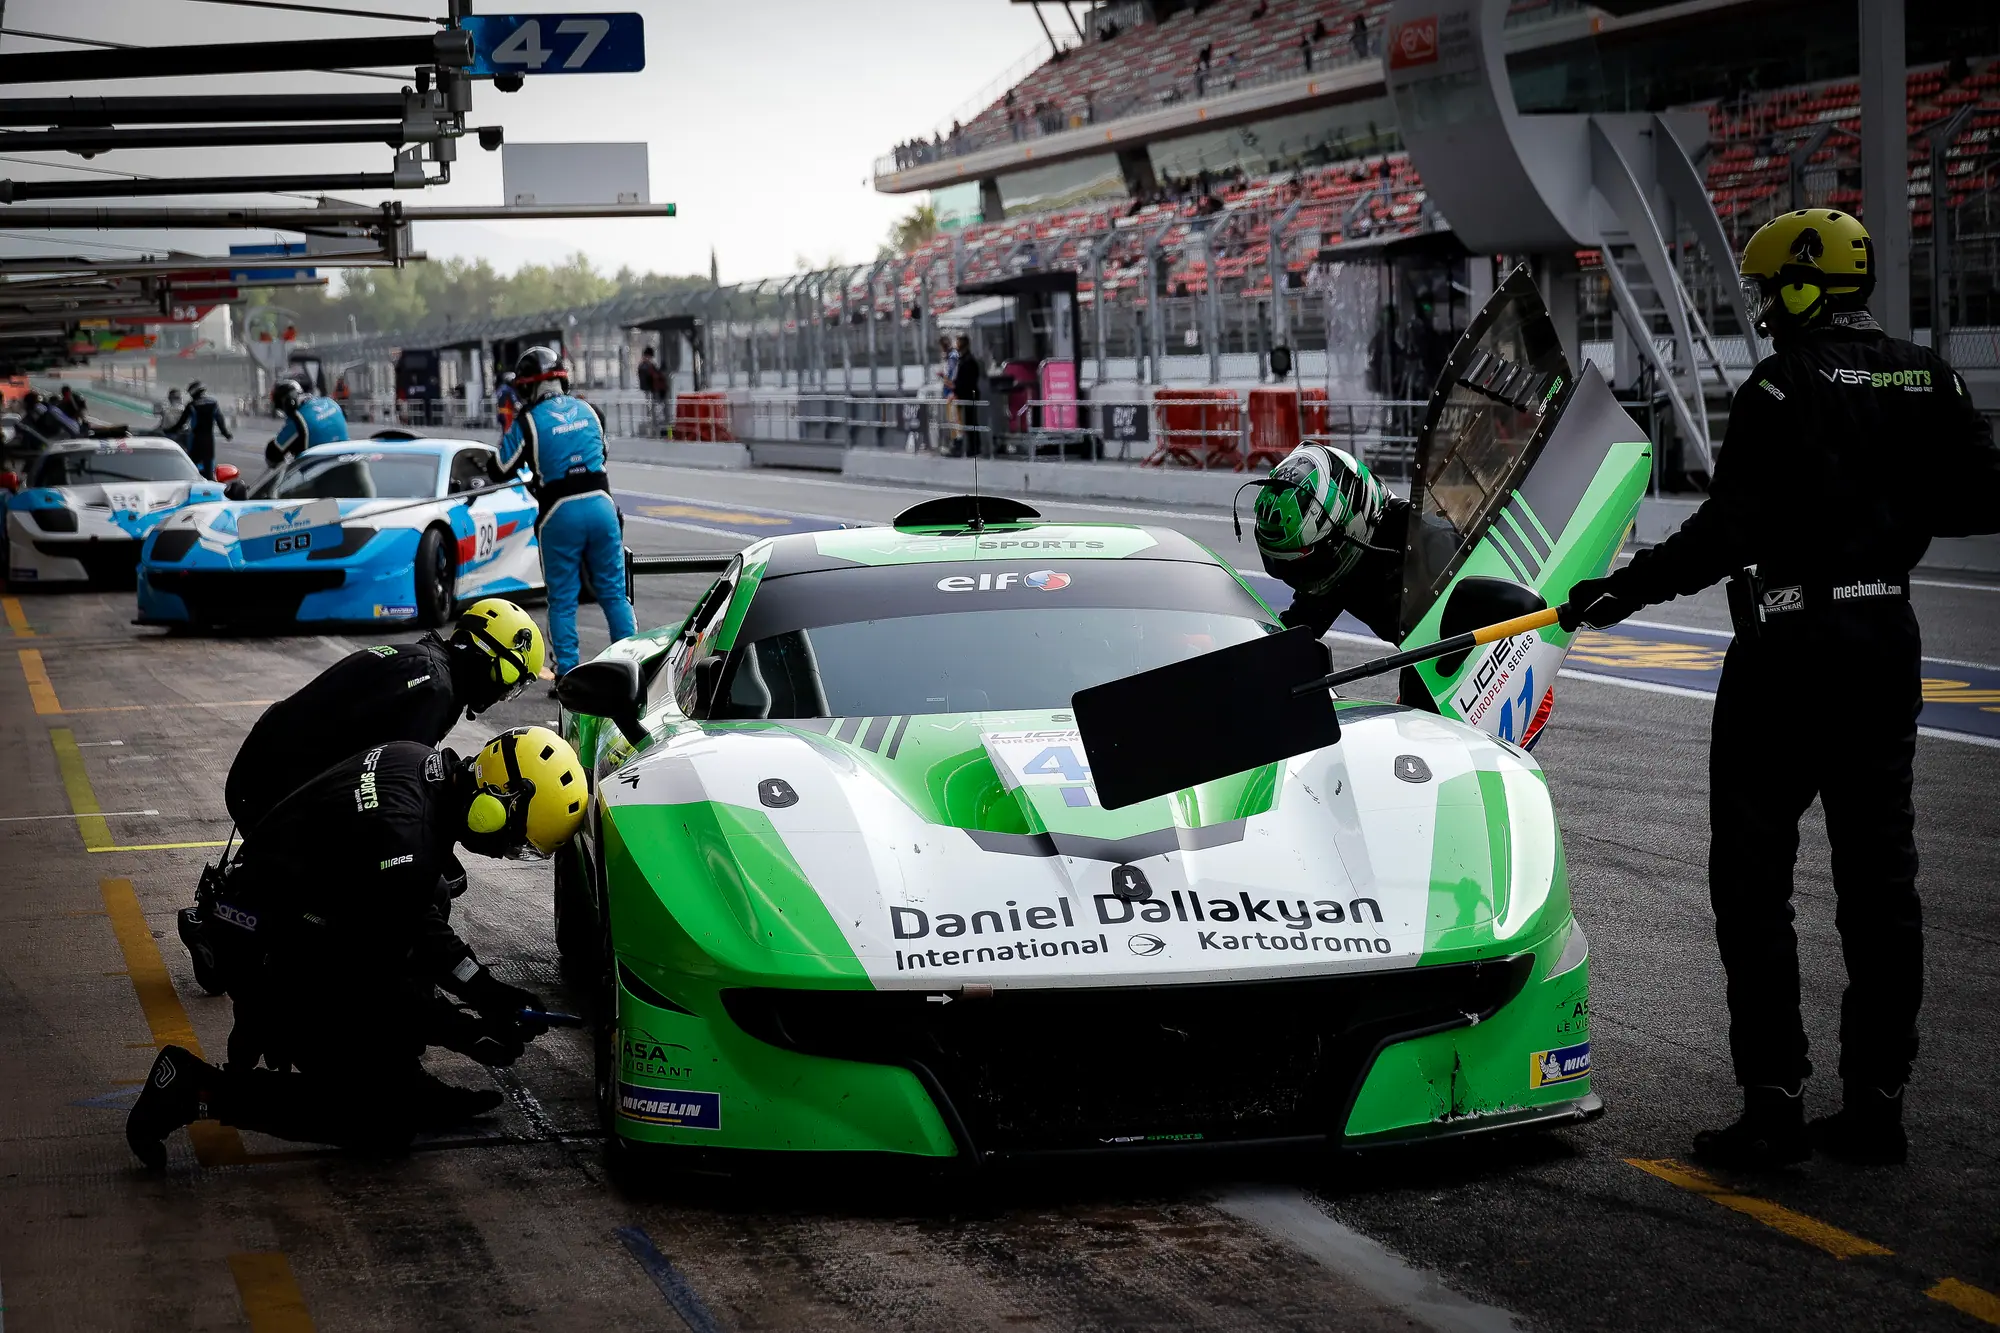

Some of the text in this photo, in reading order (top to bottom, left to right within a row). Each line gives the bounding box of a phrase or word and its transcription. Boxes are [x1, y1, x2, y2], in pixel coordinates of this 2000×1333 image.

[492, 20, 610, 69] 47
[173, 305, 198, 320] 54
[480, 523, 494, 556] 29
[979, 541, 1104, 549] SPORTS
[937, 573, 1018, 591] elf
[1833, 579, 1901, 599] mechanix.com
[1782, 602, 1802, 611] WEAR
[1470, 634, 1534, 726] EUROPEAN SERIES
[360, 772, 379, 809] SPORTS
[214, 902, 257, 927] arco
[890, 890, 1384, 940] Daniel Dallakyan
[896, 931, 1392, 971] International Kartodromo
[1557, 1023, 1571, 1033] LE
[623, 1040, 668, 1062] ASA
[623, 1096, 701, 1117] MICHELIN
